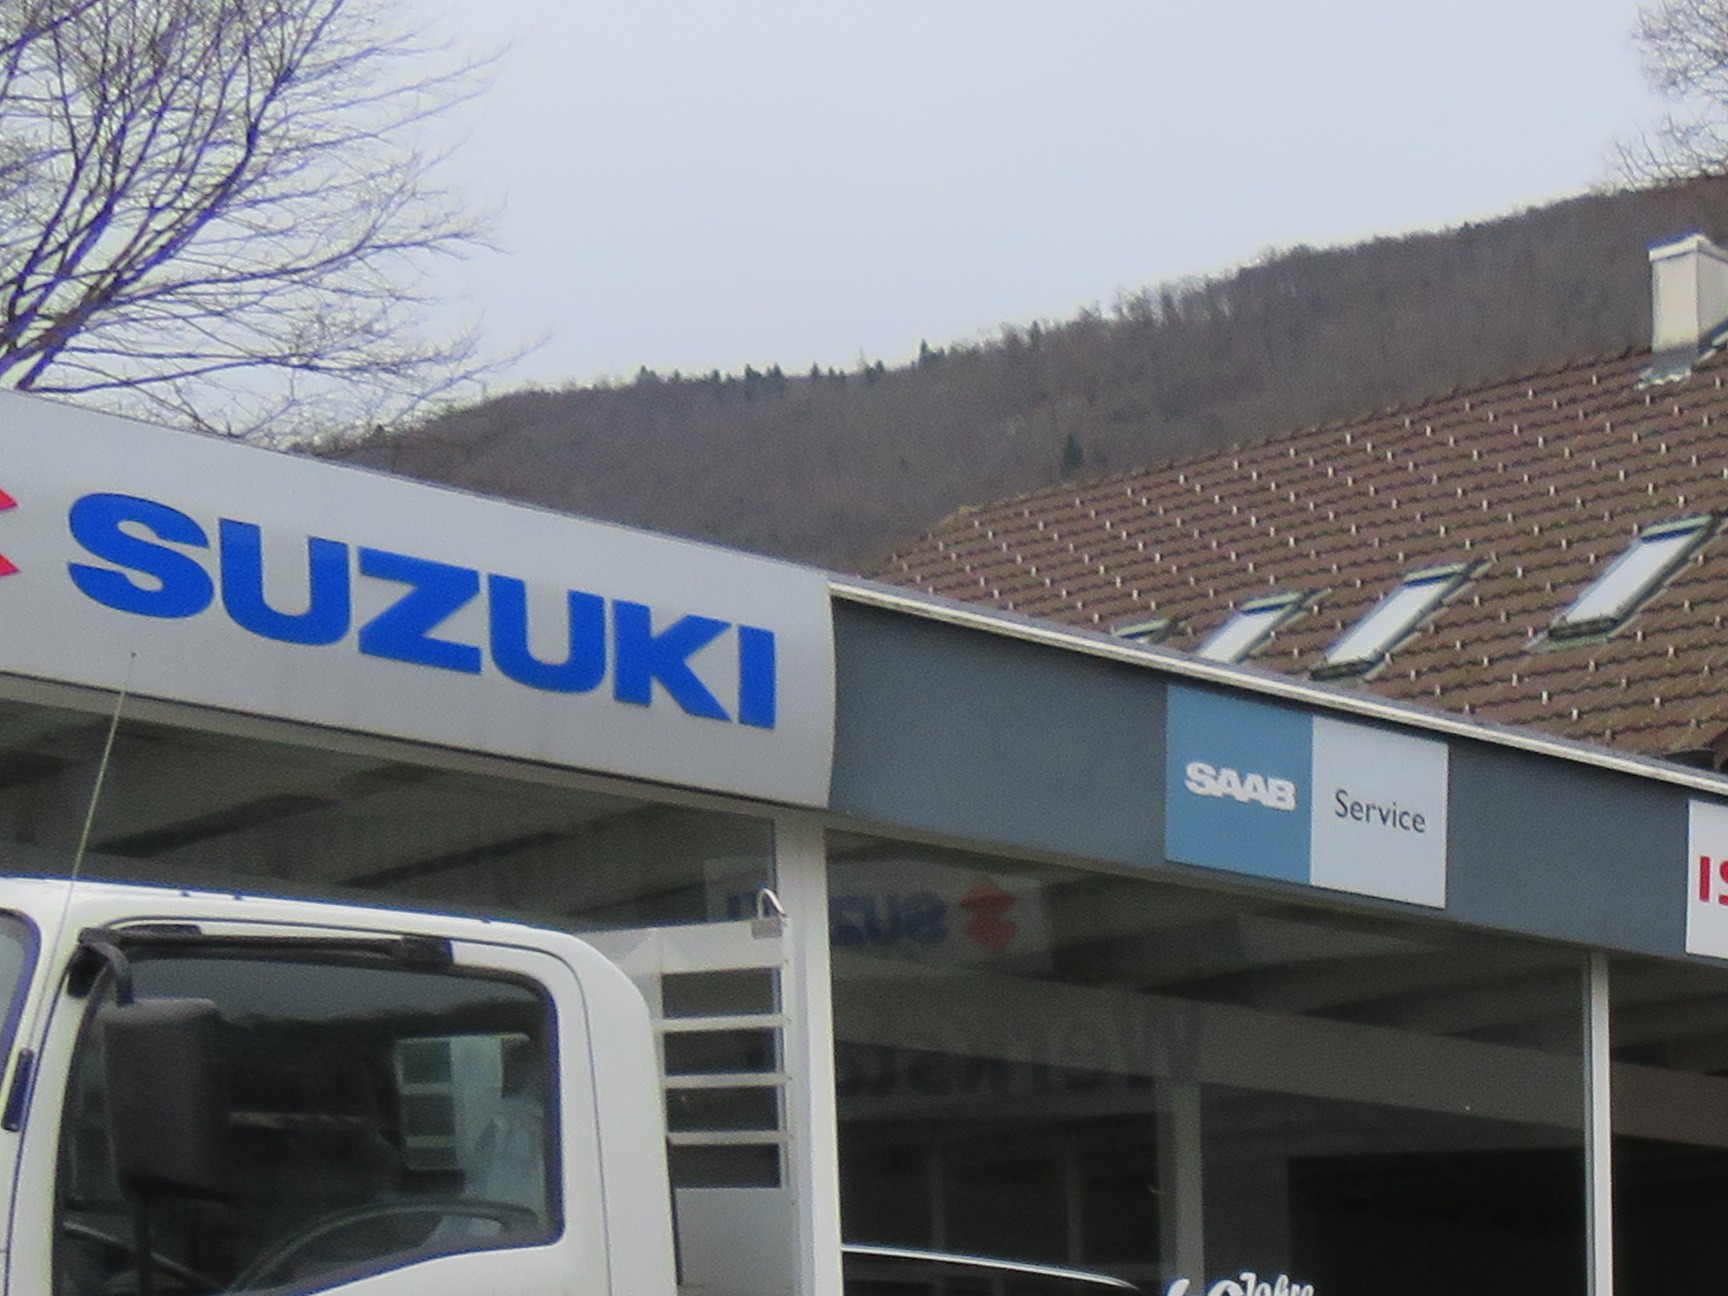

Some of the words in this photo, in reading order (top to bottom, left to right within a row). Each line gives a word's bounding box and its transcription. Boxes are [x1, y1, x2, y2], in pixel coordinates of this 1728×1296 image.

[68, 492, 776, 730] SUZUKI
[1184, 761, 1297, 812] SAAB
[1334, 789, 1427, 834] Service
